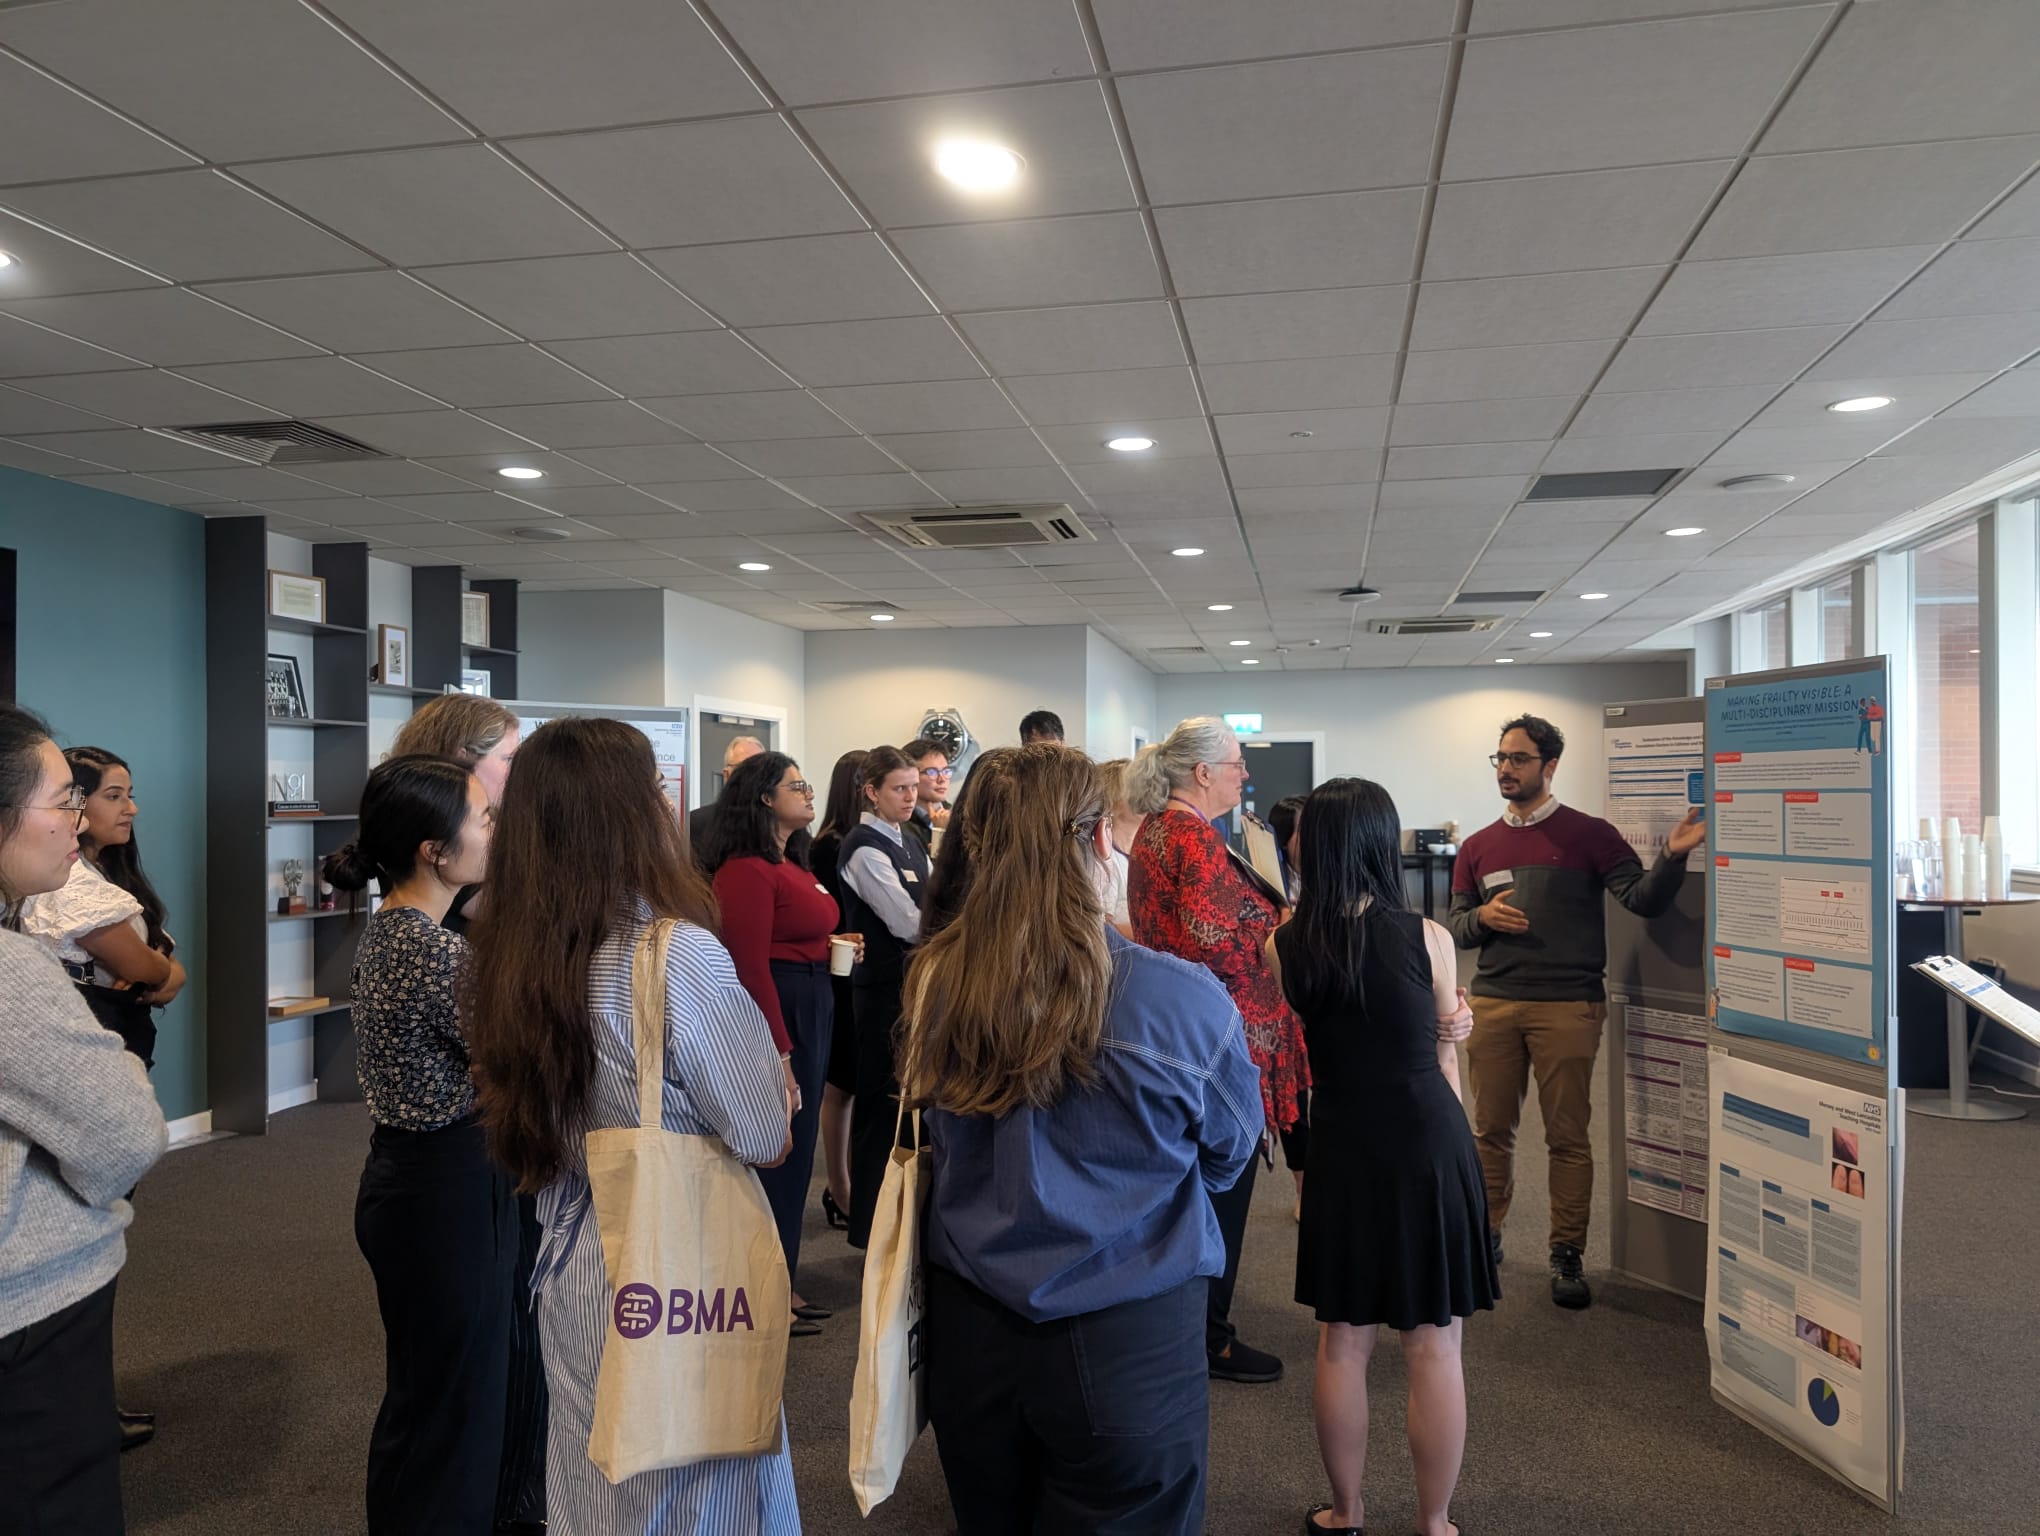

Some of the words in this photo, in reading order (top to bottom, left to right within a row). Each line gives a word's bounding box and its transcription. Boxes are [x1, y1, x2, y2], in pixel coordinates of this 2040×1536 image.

[1727, 694, 1760, 708] MAKING
[1763, 689, 1800, 706] FRAILTY
[1801, 685, 1842, 700] VISIBLE:
[1844, 684, 1852, 697] A
[1721, 704, 1812, 721] MULTI-DISCIPLINARY
[1814, 700, 1859, 714] MISSION
[1864, 1103, 1881, 1116] NHS
[667, 1287, 754, 1335] BMA
